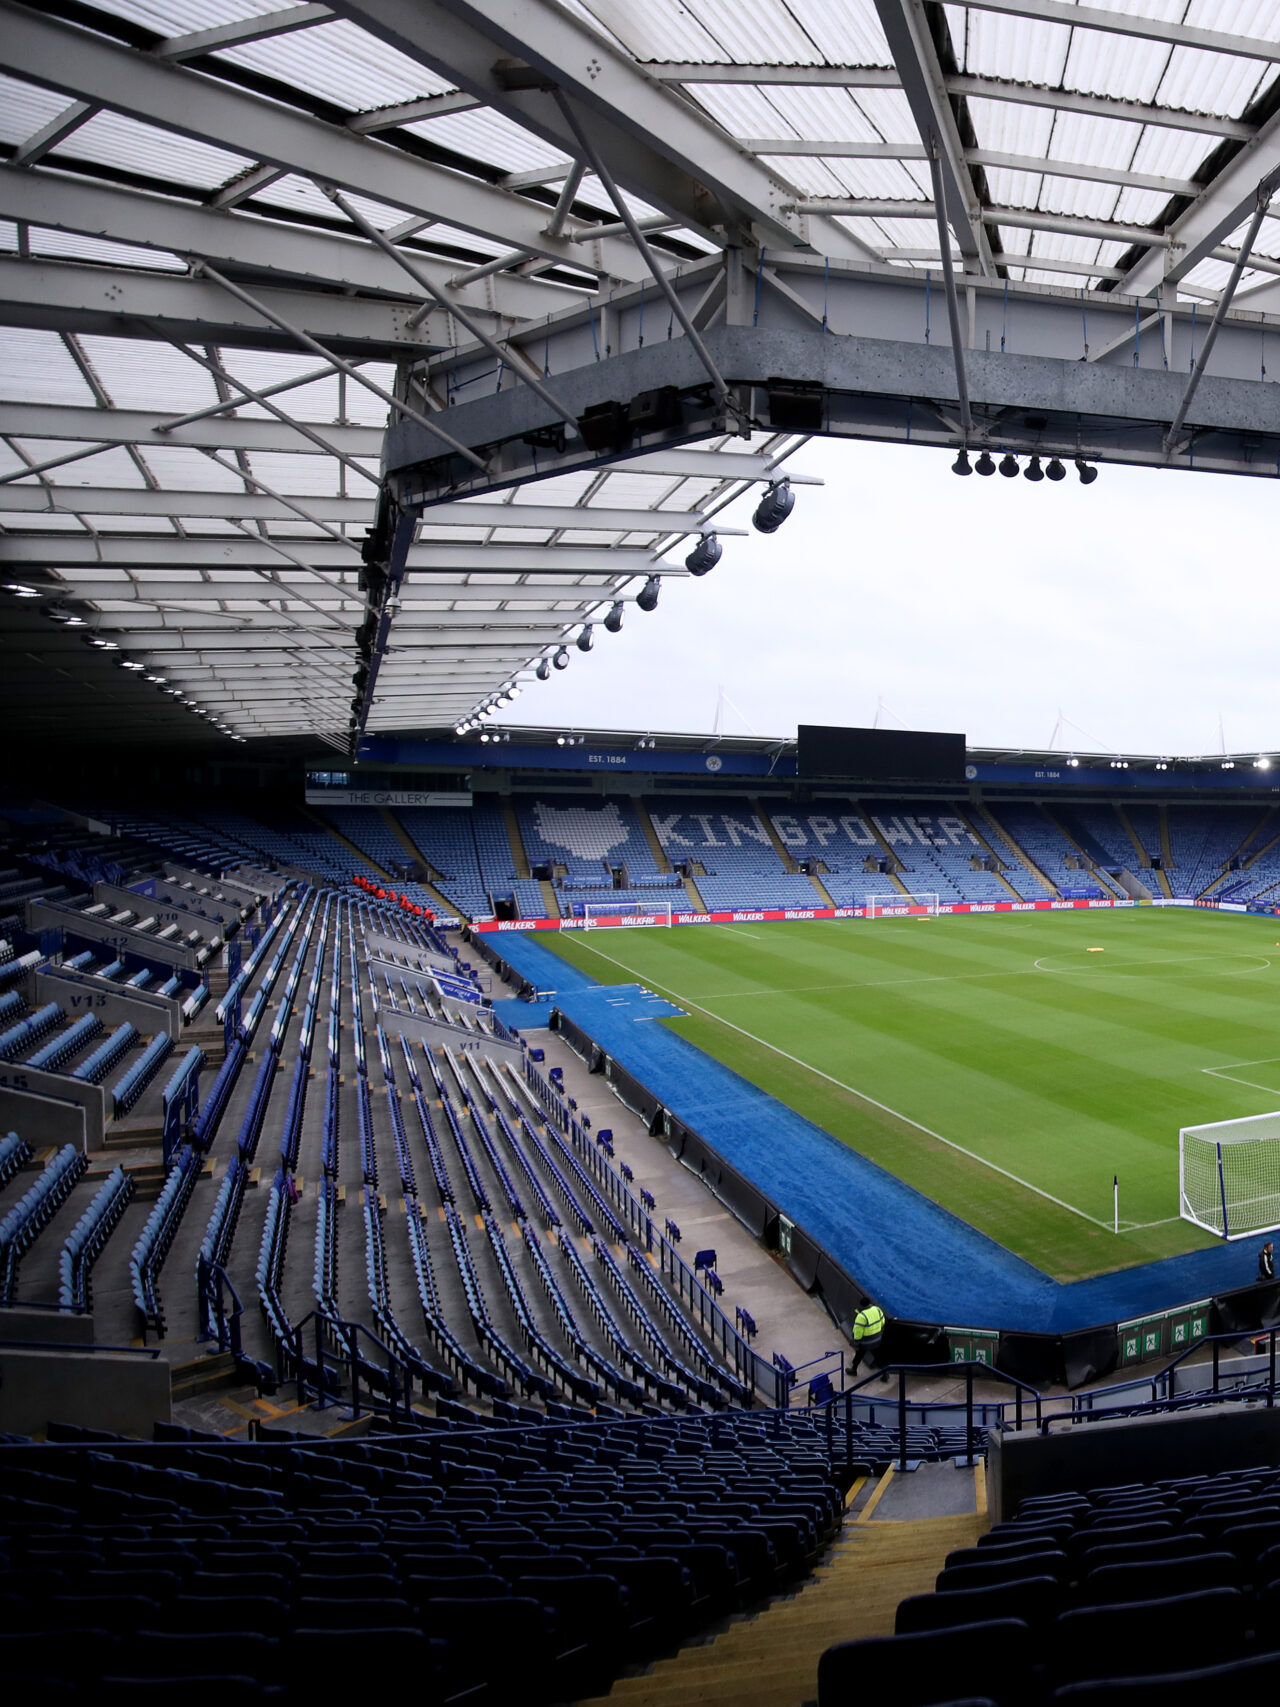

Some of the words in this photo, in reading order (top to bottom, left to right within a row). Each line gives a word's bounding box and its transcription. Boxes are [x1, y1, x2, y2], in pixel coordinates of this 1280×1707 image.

[588, 755, 604, 763] EST.
[348, 792, 370, 804] THE
[374, 793, 431, 804] GALLERY
[678, 914, 711, 923] WALKERS
[733, 912, 764, 921] WALKERS
[785, 910, 815, 919] WALKERS
[498, 920, 536, 931] WALKERS
[561, 918, 597, 928] WALKRS
[100, 936, 129, 948] V12
[70, 995, 107, 1008] V13
[460, 1042, 481, 1050] V11
